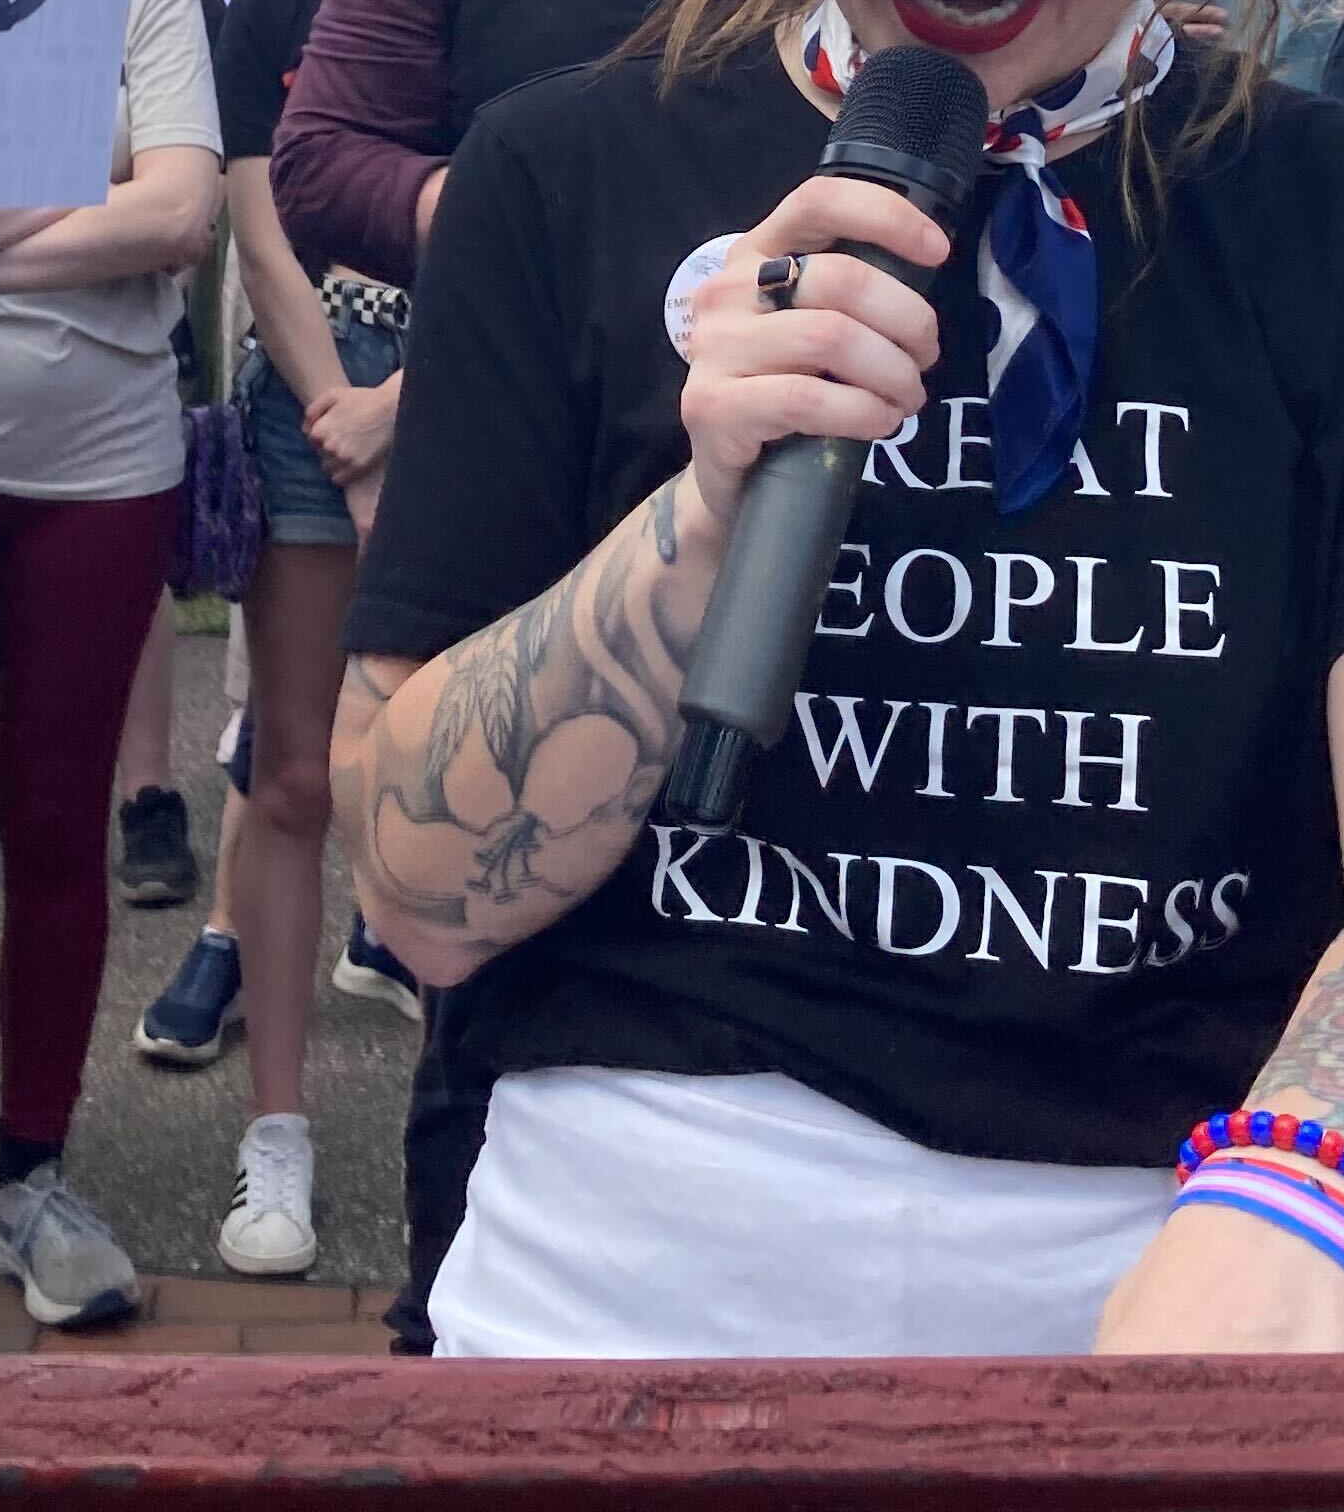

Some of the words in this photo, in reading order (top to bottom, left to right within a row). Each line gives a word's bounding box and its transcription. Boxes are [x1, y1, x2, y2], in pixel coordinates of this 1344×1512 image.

[813, 542, 1226, 659] EOPLE
[793, 689, 1151, 812] WITH
[649, 822, 1251, 976] KINDNESS
